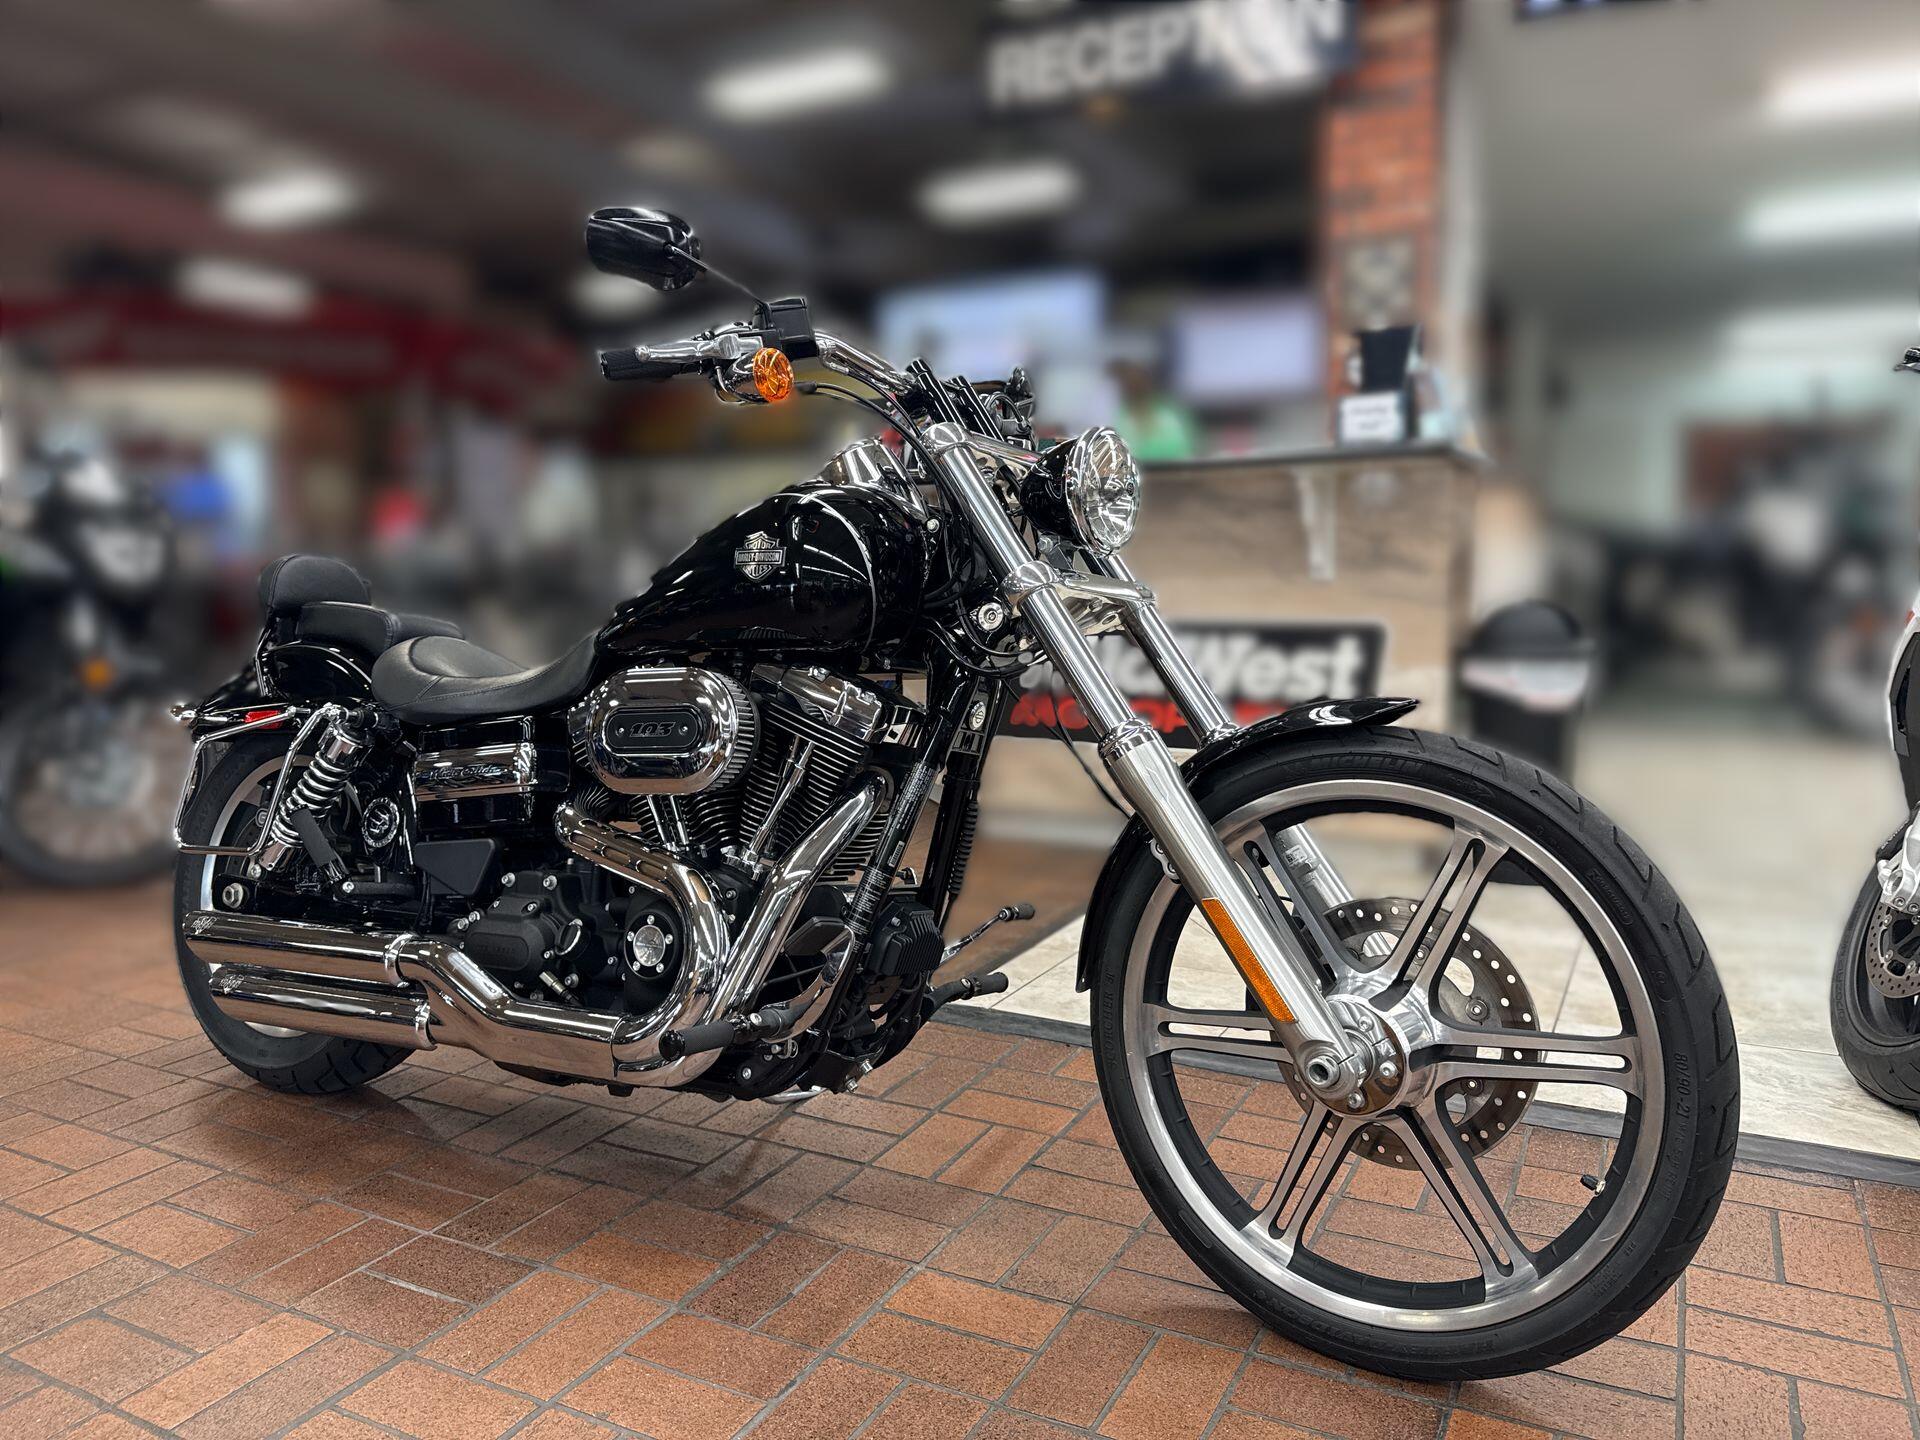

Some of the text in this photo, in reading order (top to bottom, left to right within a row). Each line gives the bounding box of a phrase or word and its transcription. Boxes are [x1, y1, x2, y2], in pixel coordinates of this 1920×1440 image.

[629, 721, 676, 738] 103
[1309, 755, 1424, 774] MICHELIN
[1673, 1052, 1690, 1119] 80/90-21
